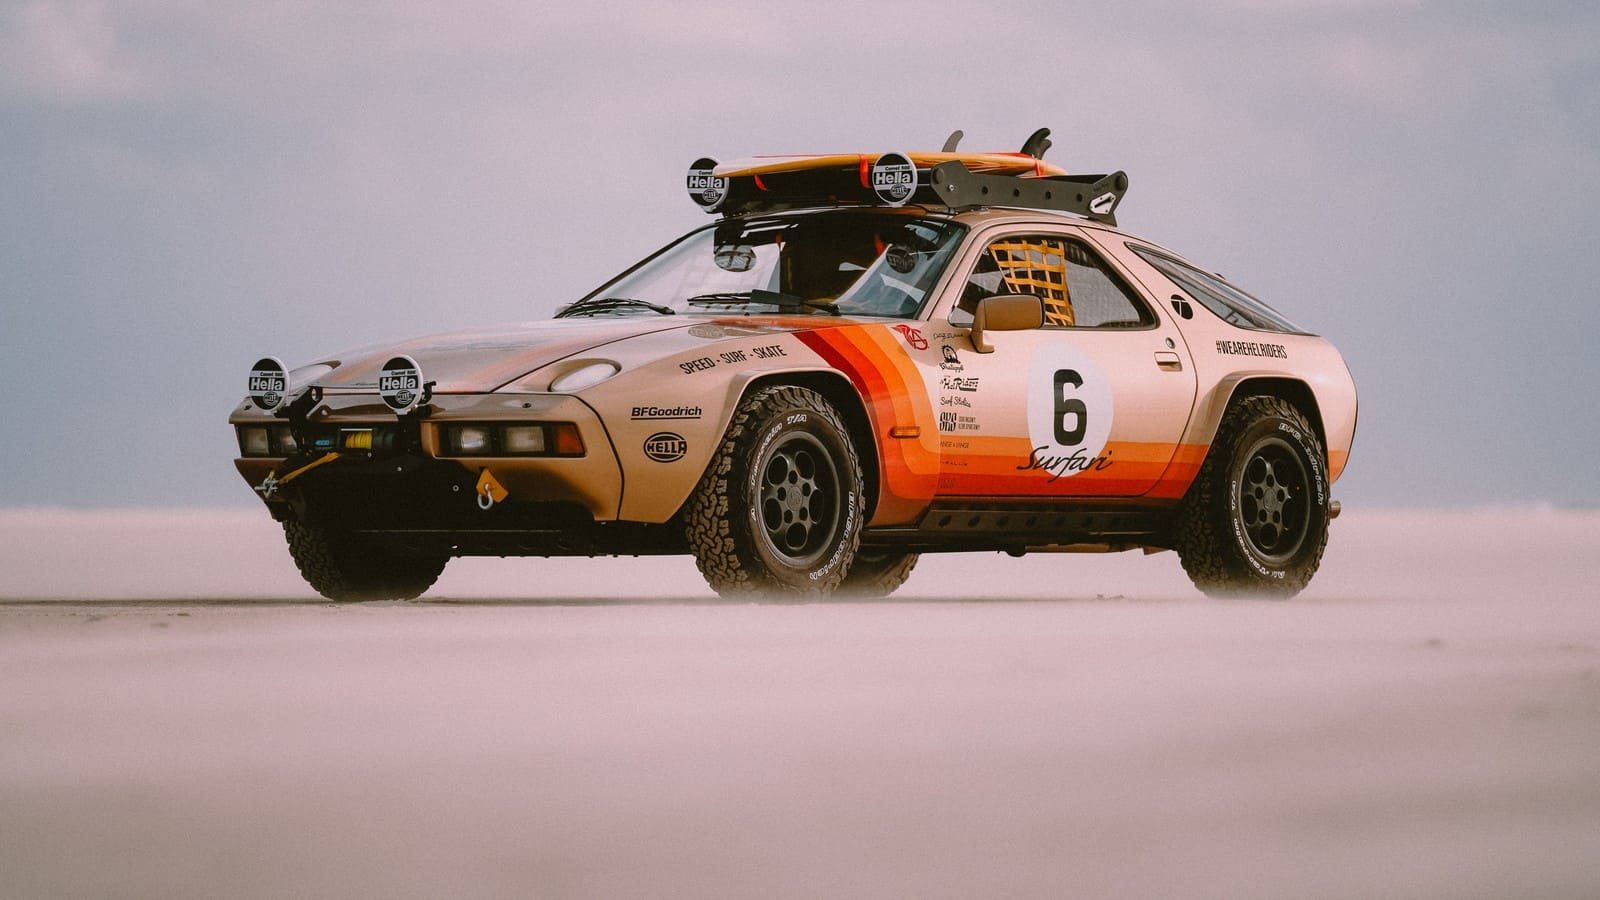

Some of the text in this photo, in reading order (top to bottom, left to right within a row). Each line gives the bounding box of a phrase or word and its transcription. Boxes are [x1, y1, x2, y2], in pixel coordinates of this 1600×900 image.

[688, 176, 723, 188] Hella
[875, 171, 911, 185] Hella
[1216, 340, 1288, 359] #WEAREHELRIDERS
[679, 344, 787, 374] SPEED SURF SKATE
[250, 378, 283, 391] Hella
[381, 376, 416, 390] Hella
[631, 406, 702, 417] BFGoodrich
[1053, 369, 1087, 446] 6
[647, 440, 687, 454] HELLA
[1016, 445, 1113, 483] Surfari
